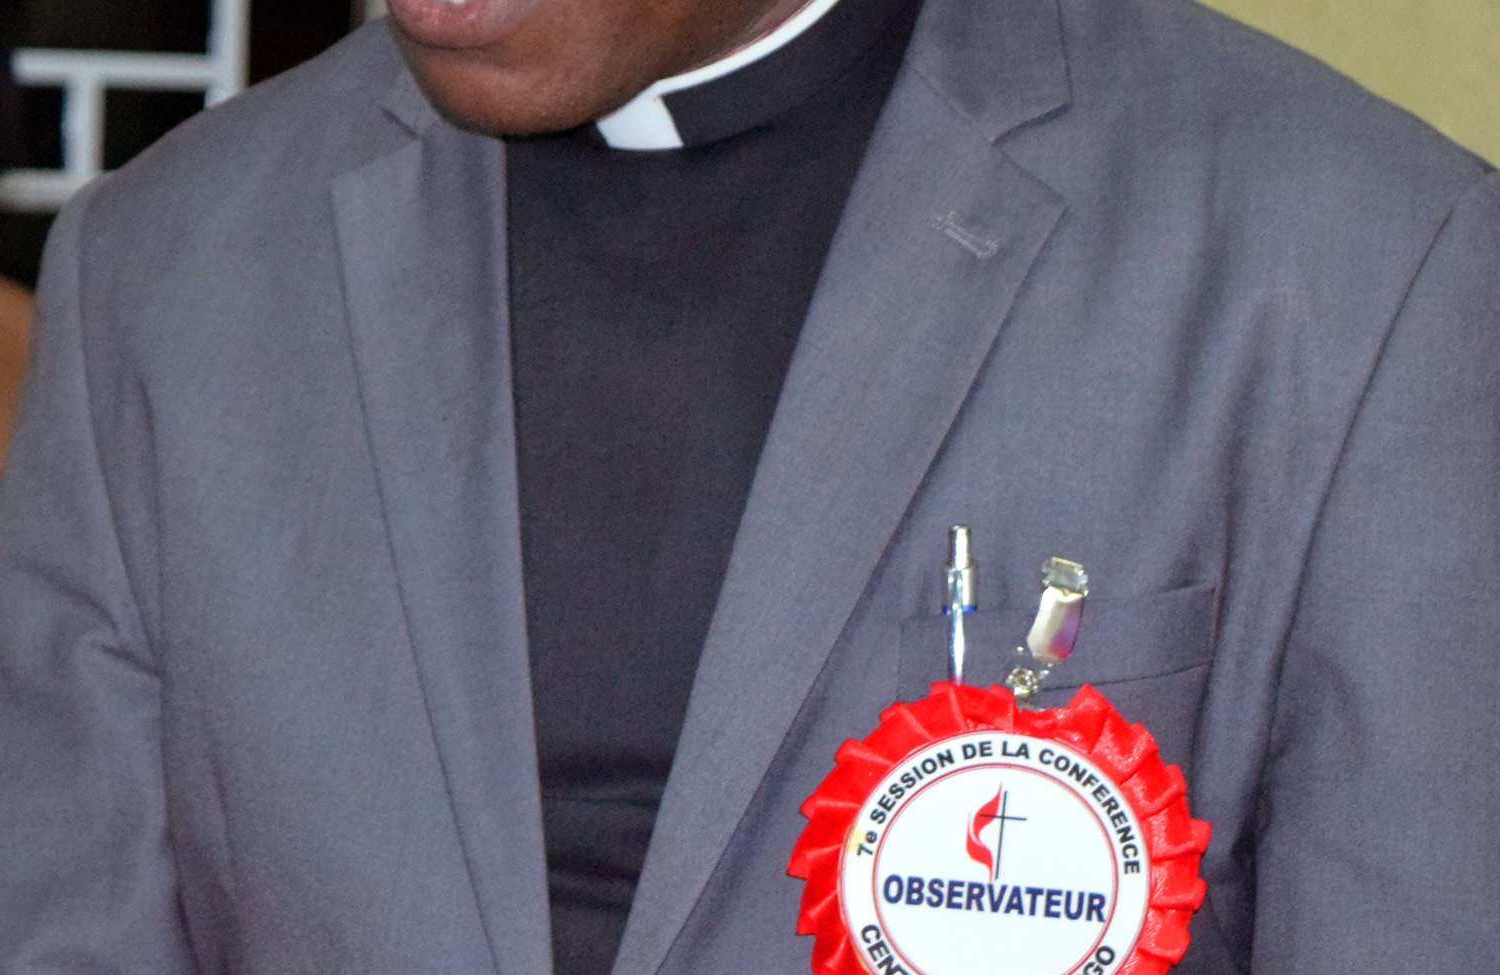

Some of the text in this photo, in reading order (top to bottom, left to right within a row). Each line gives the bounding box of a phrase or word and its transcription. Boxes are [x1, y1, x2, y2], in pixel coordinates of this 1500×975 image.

[857, 740, 1140, 875] 7e SESSION DE LA CONFERENCE
[883, 874, 1106, 922] OBSERVATEUR
